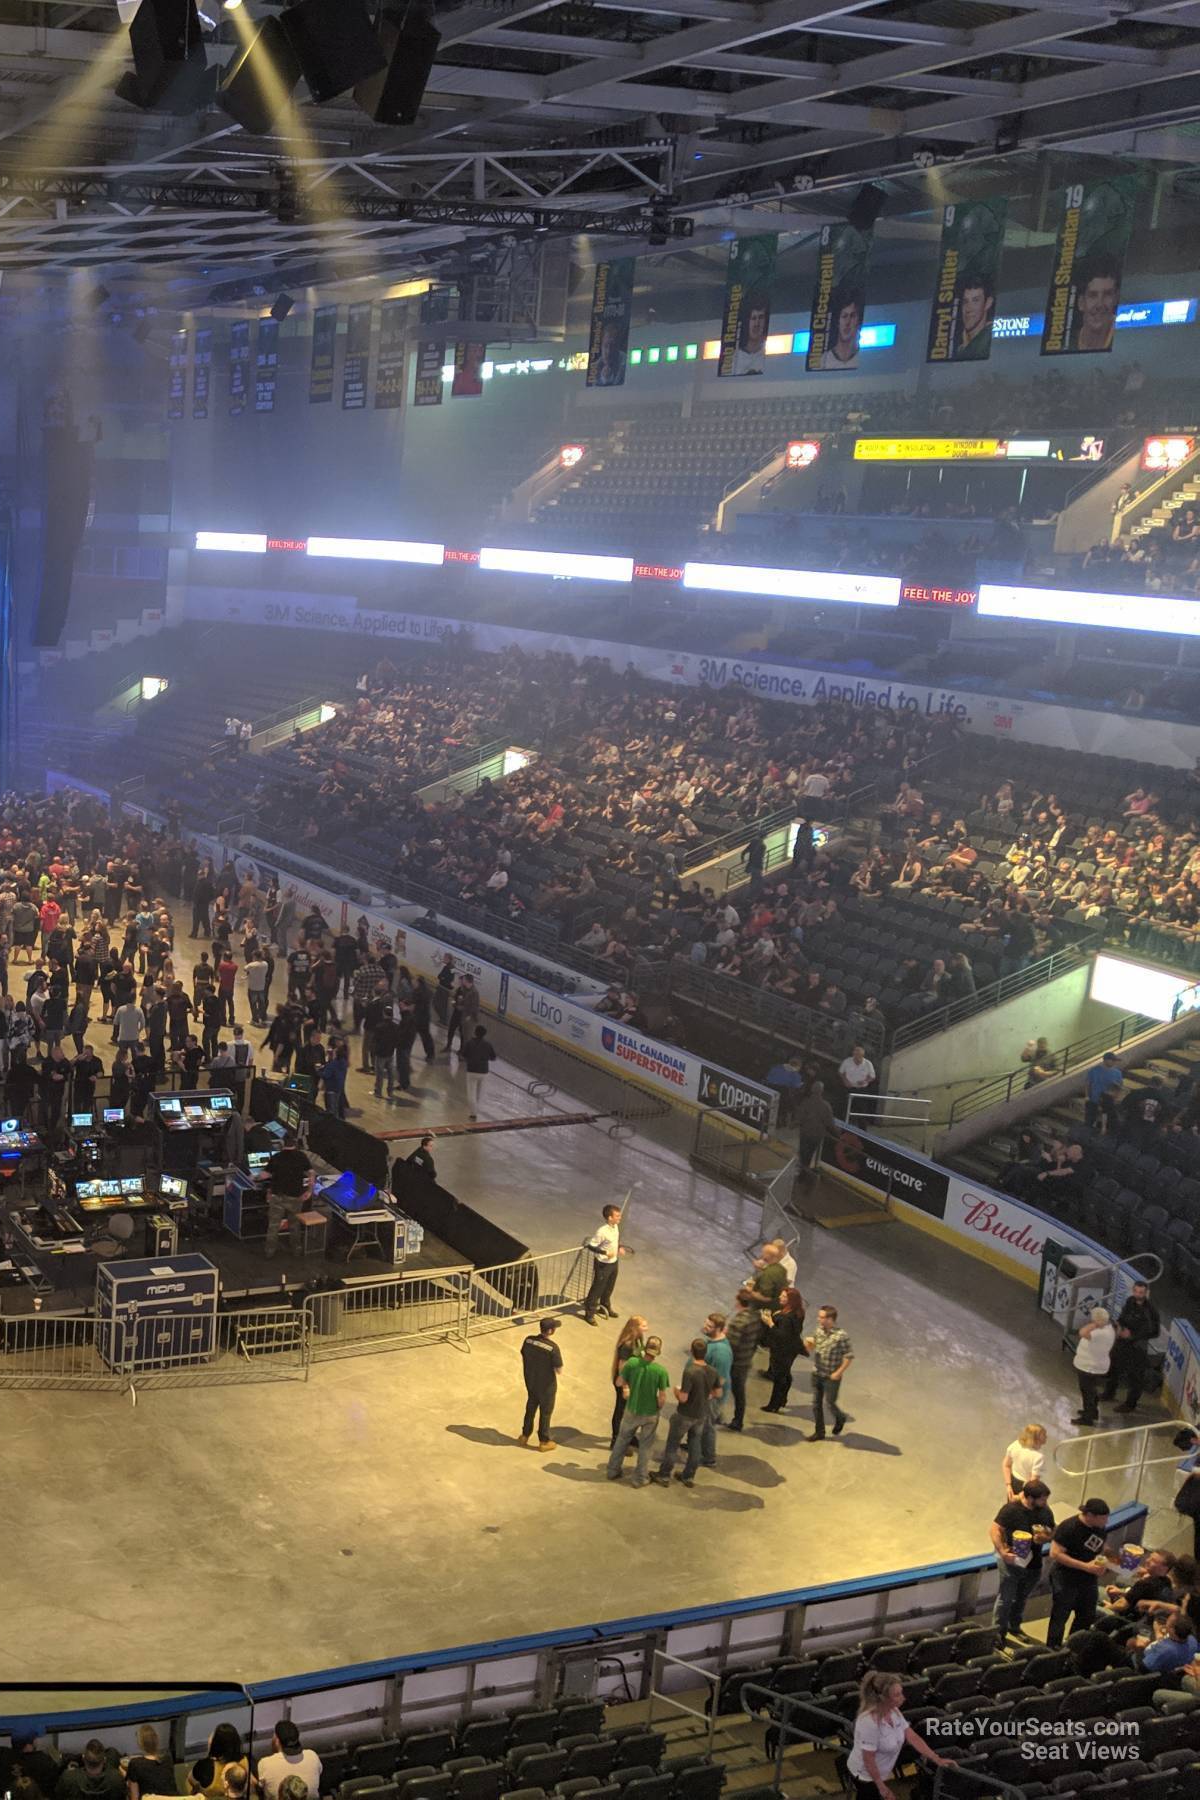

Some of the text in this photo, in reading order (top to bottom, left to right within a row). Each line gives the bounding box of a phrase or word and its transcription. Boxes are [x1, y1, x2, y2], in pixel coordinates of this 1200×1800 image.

[1065, 184, 1085, 208] 19
[945, 206, 955, 227] 9
[730, 241, 739, 260] 5
[1054, 208, 1080, 286] Shanahan
[812, 254, 835, 329] Ciccarelli
[930, 308, 952, 361] Darryl
[1045, 287, 1069, 351] Brendan
[268, 540, 307, 551] FEEL THE JOY
[444, 551, 481, 562] FEEL THE JOY
[635, 566, 684, 579] FEEL THE JOY
[903, 587, 976, 604] FEEL THE JOY
[264, 604, 290, 622] 3M
[353, 612, 406, 636] Applied
[410, 616, 421, 634] to
[698, 659, 972, 725] 3M Science. Applied to Life.
[993, 713, 1013, 729] 3M
[530, 992, 562, 1024] Libro
[617, 1033, 687, 1073] REAL CANADIAN
[865, 1156, 924, 1193] enercare
